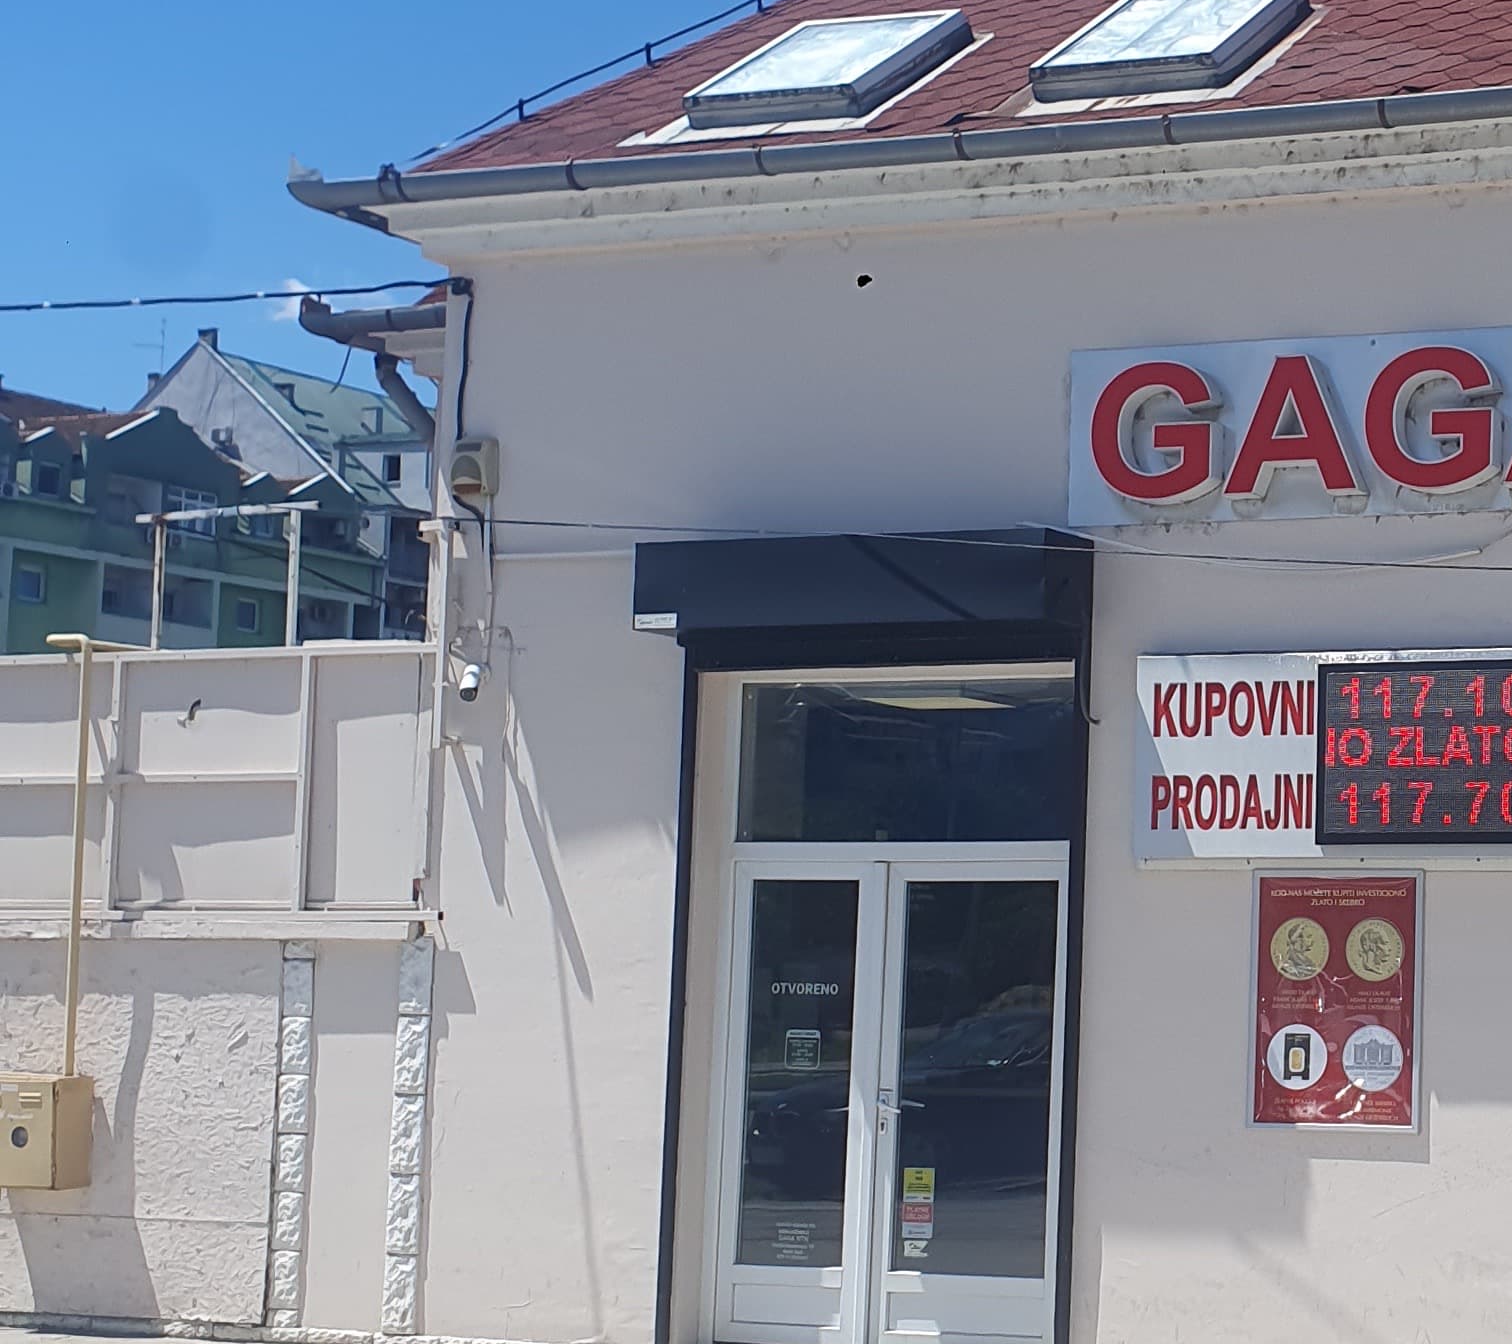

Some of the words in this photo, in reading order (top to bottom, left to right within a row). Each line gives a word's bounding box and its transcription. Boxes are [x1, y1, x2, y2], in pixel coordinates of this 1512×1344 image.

[1153, 679, 1315, 738] KUPOVNI
[1151, 773, 1314, 830] PRODAJNI
[771, 982, 839, 995] OTVORENO
